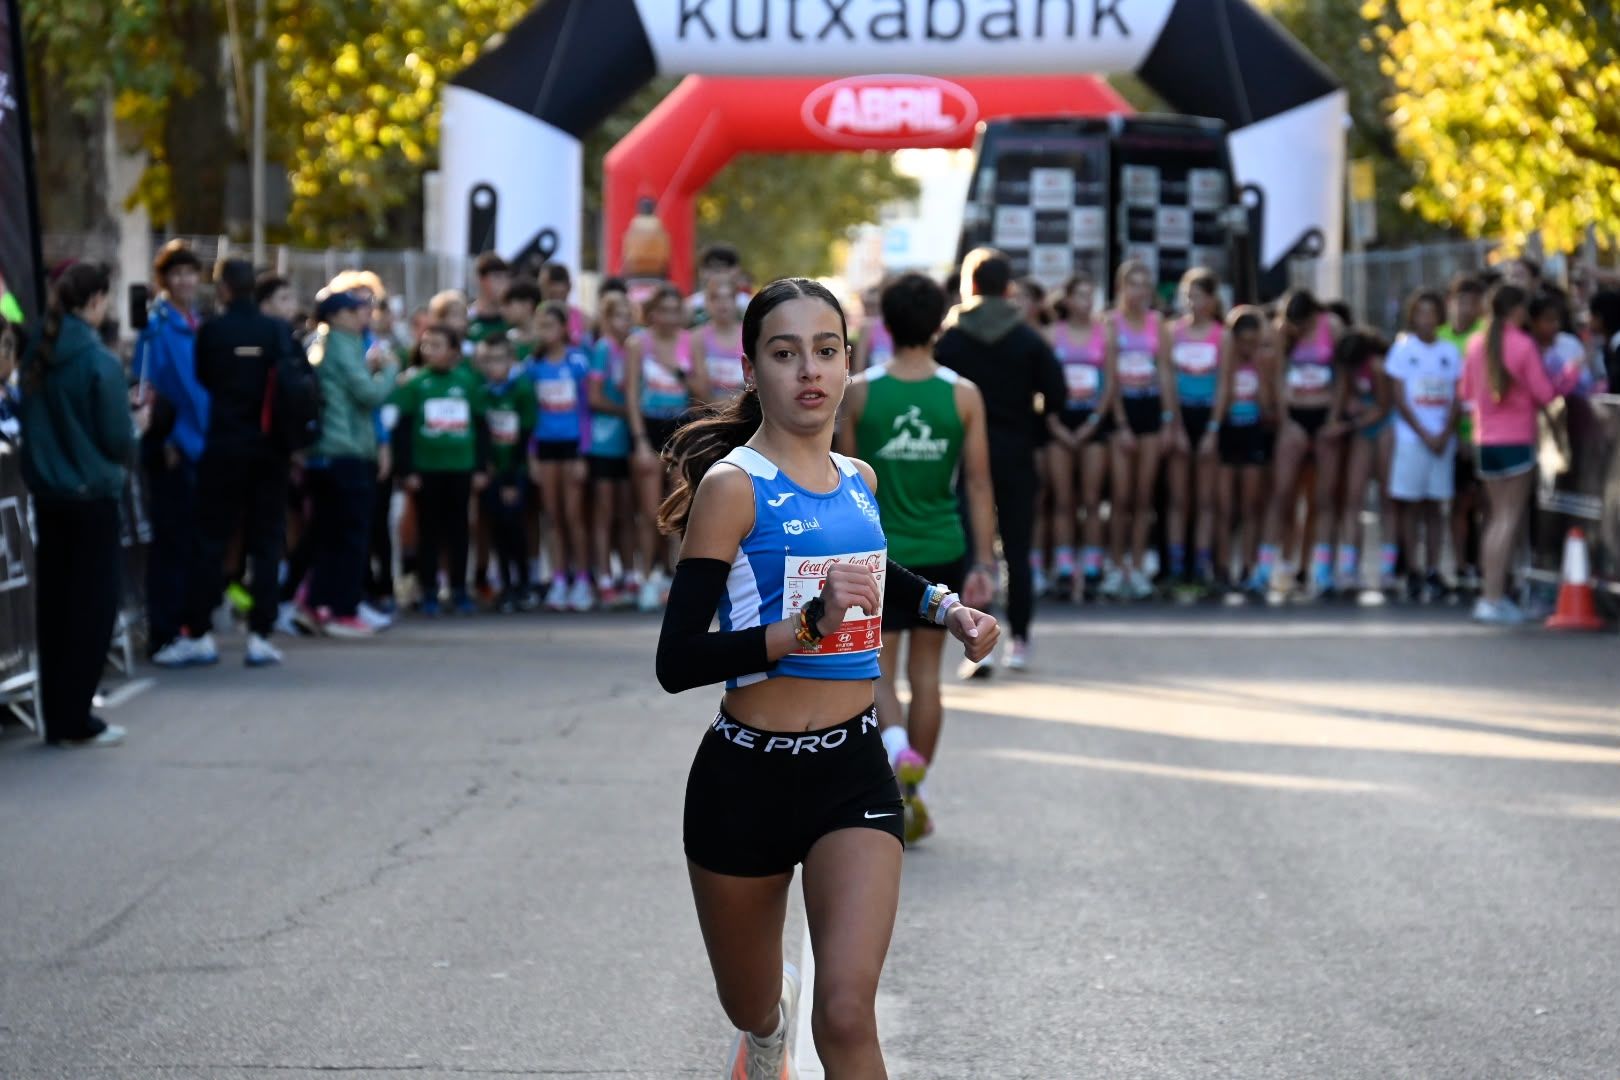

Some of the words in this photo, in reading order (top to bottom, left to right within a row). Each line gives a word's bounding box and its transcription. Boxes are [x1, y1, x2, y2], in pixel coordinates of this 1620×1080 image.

[676, 0, 1132, 42] kutxabank
[826, 87, 957, 132] ABRIL
[712, 711, 762, 749] IKE
[764, 729, 848, 755] PRO
